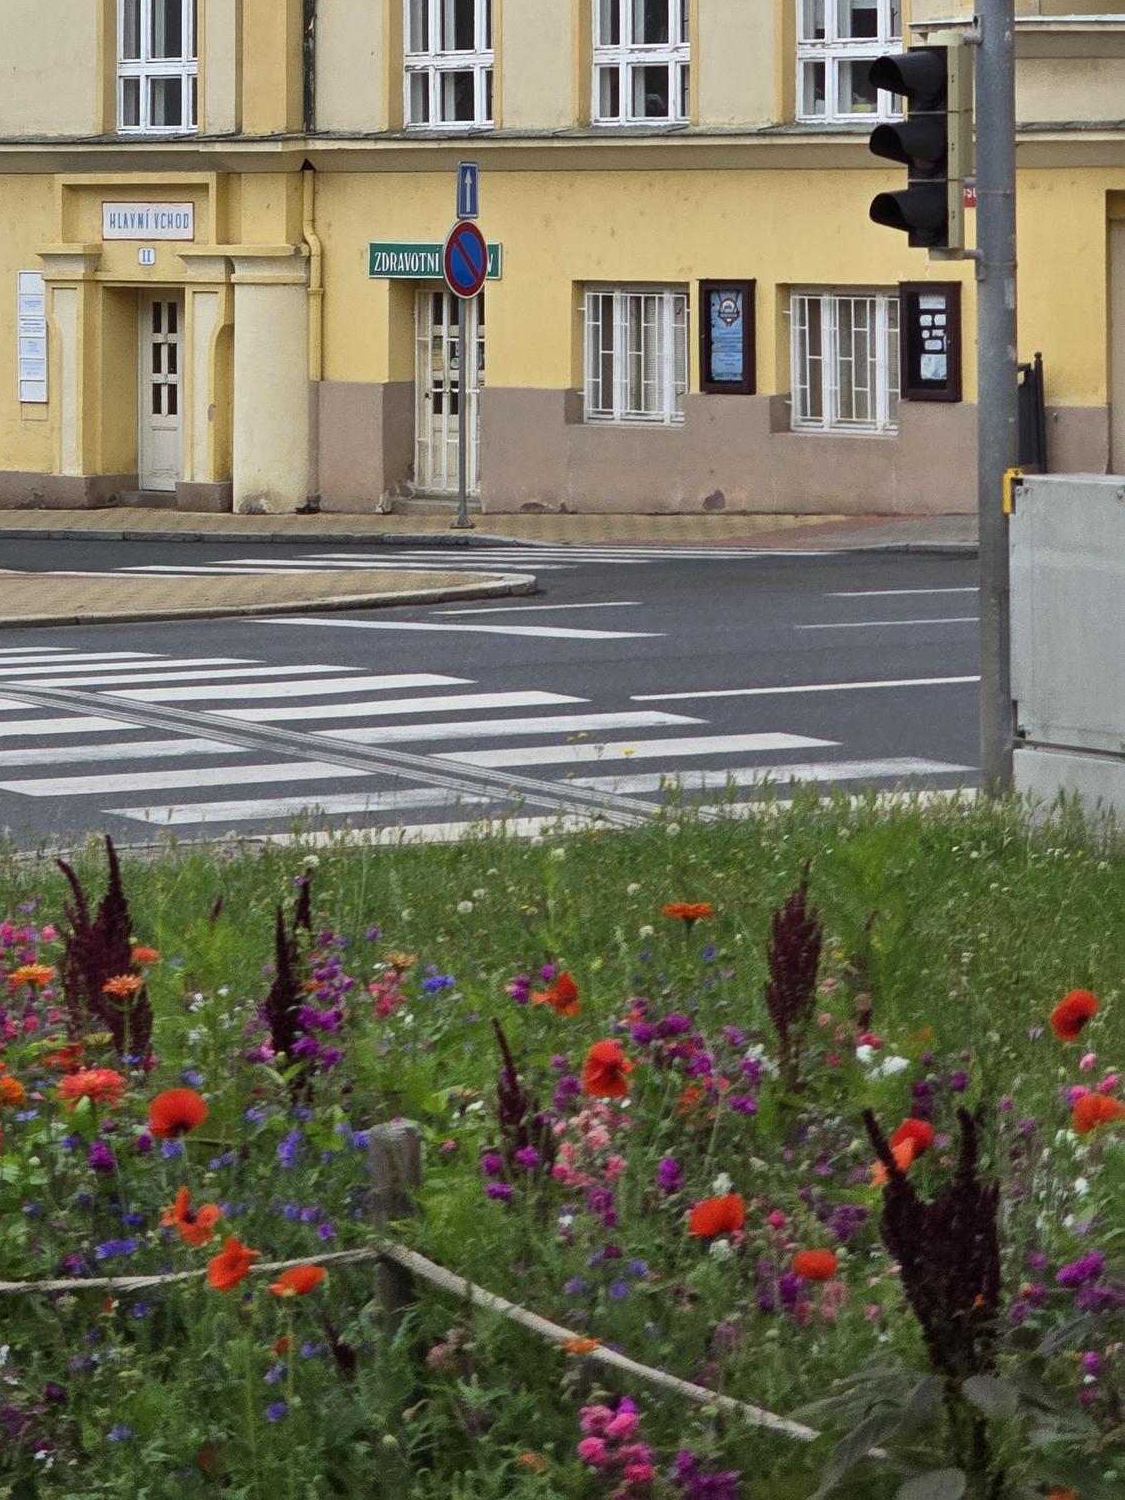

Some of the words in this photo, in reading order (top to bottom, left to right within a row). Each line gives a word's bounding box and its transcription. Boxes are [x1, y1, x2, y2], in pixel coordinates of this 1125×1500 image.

[109, 208, 150, 229] HLAVNÍ
[154, 213, 189, 229] VCHOD
[374, 247, 440, 272] ZDRAVOTNÍ
